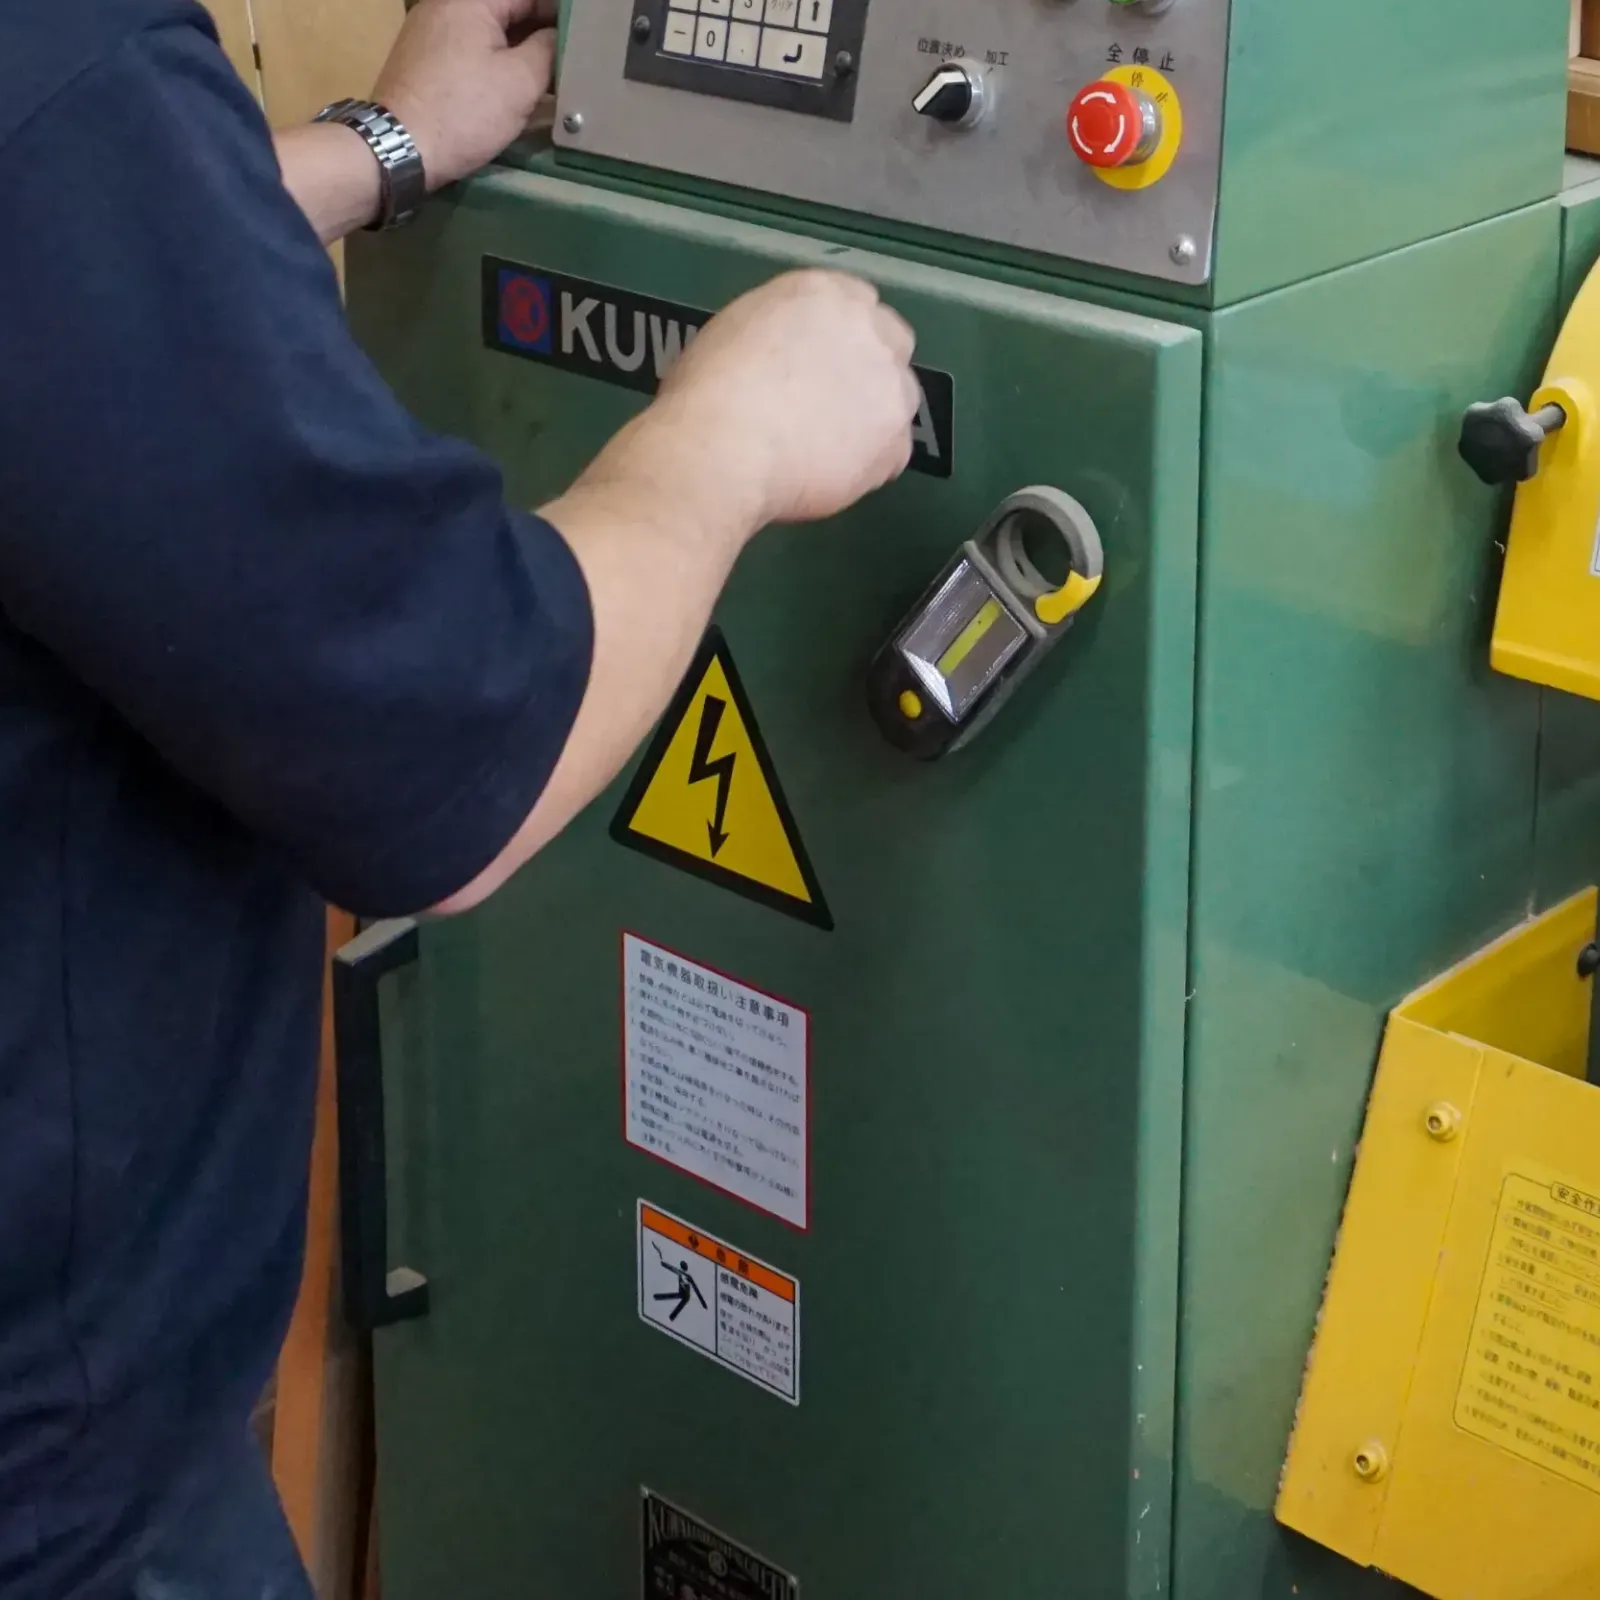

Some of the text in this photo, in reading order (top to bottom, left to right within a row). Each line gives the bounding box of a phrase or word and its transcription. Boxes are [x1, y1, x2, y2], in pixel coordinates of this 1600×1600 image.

[707, 31, 715, 47] 0
[916, 37, 966, 60] 位置決め
[985, 49, 1009, 66] 加工
[640, 948, 788, 1029] 電気機器取扱い注意事項
